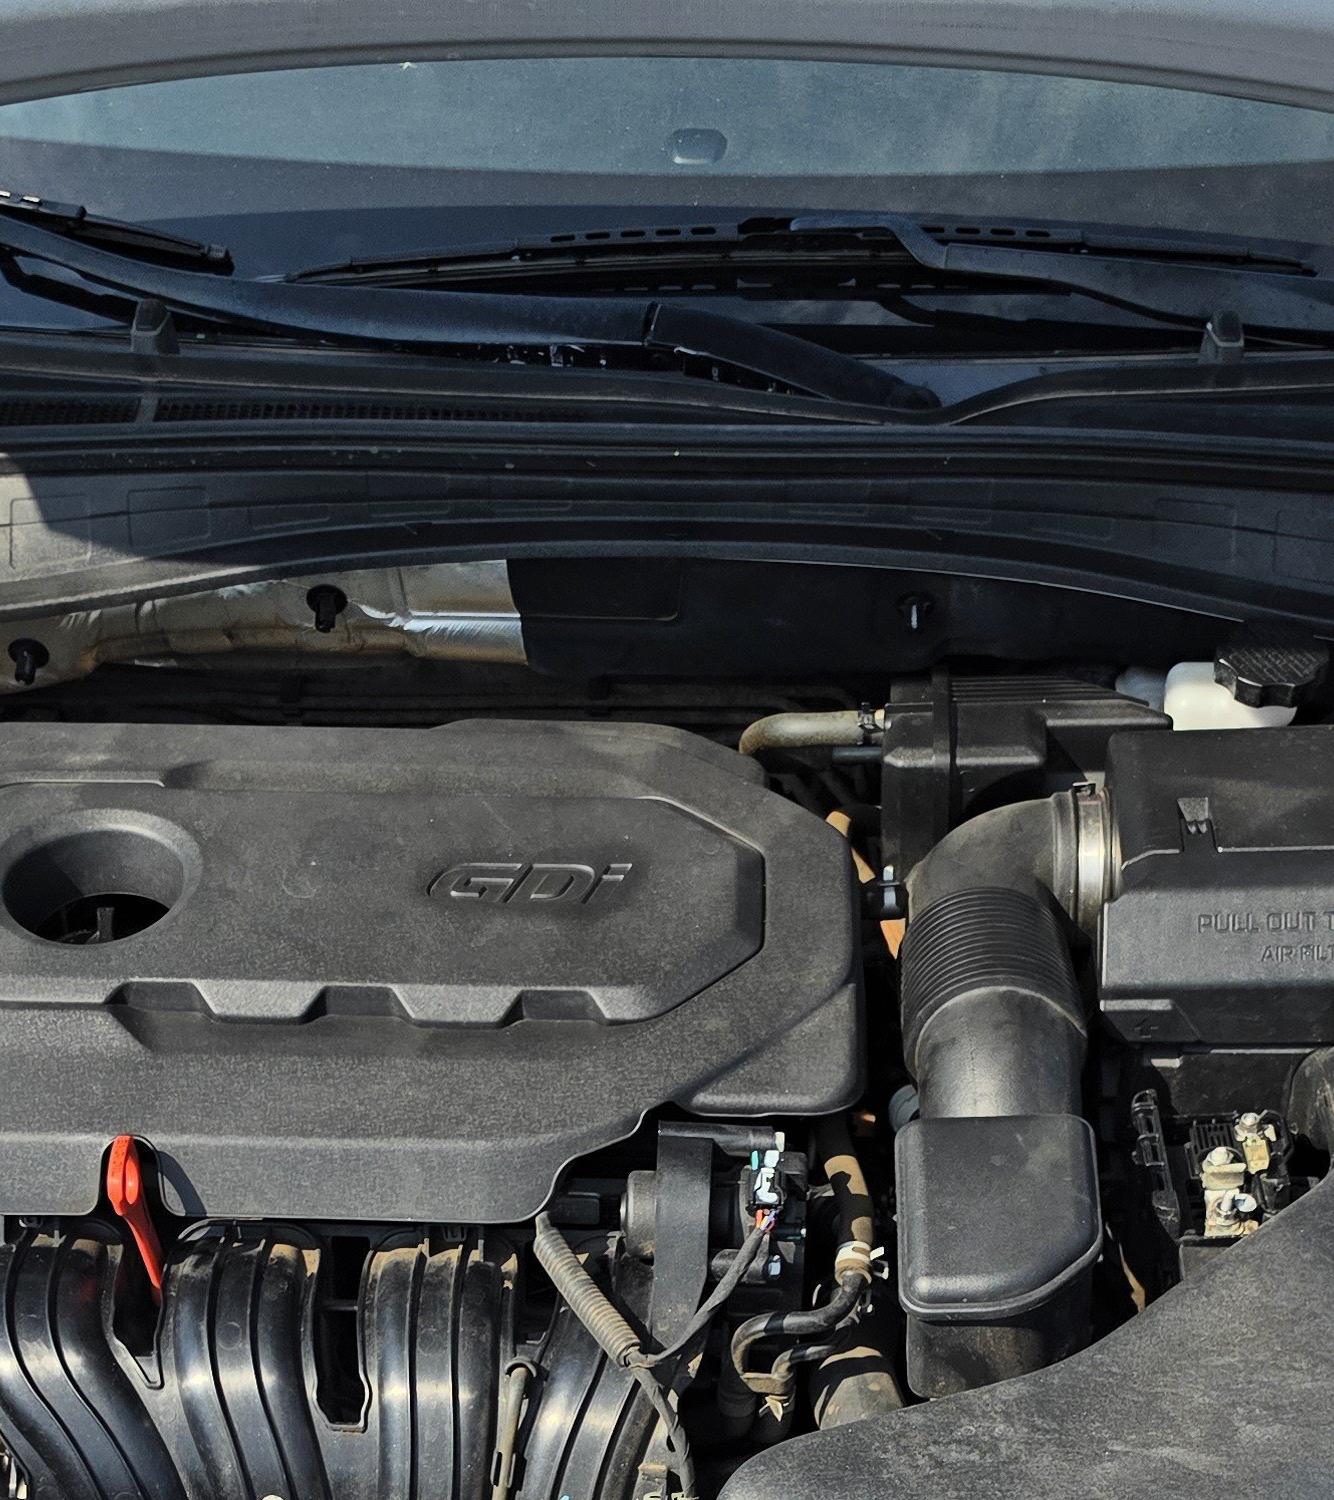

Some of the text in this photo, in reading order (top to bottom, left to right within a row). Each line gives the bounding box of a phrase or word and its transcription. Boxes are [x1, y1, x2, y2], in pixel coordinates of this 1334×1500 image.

[1196, 913, 1259, 934] PULL
[1266, 911, 1317, 932] OUT
[1260, 944, 1294, 962] AIR
